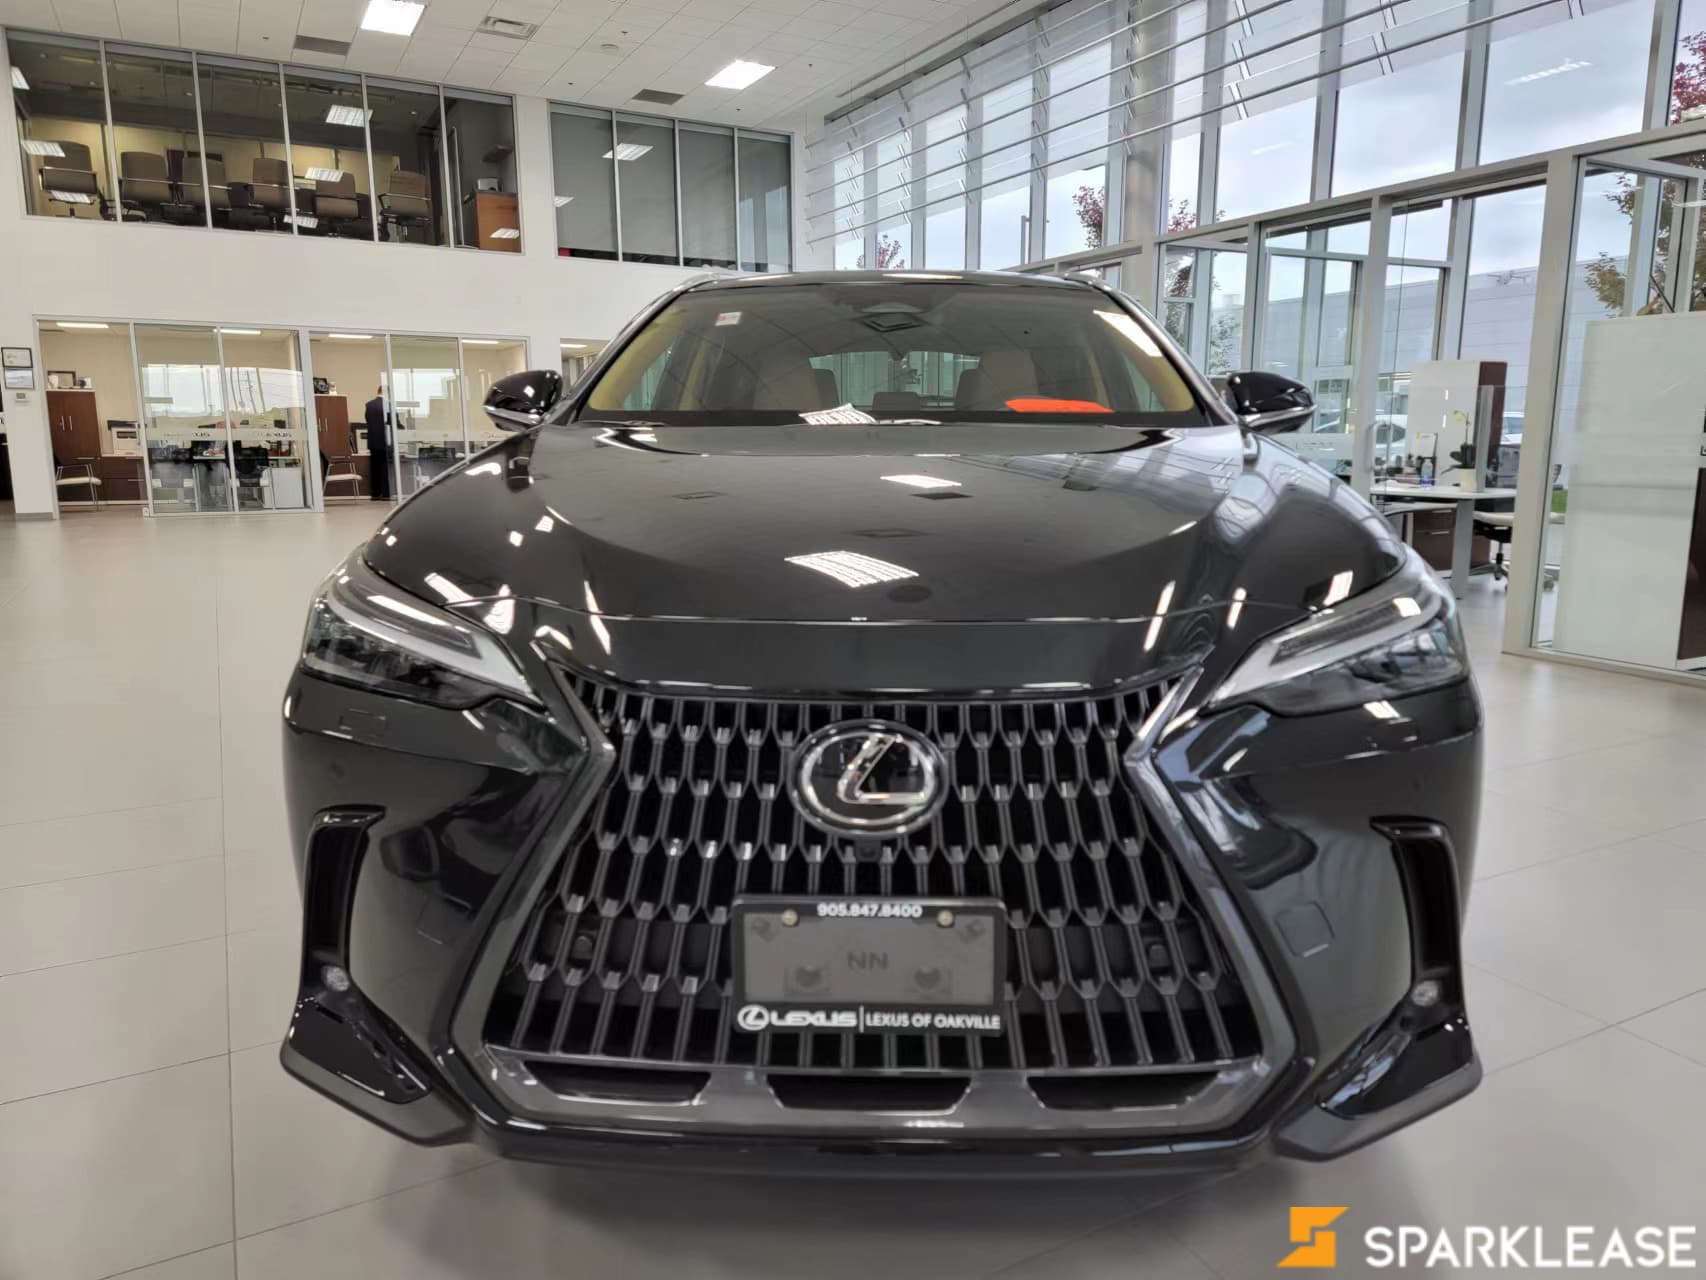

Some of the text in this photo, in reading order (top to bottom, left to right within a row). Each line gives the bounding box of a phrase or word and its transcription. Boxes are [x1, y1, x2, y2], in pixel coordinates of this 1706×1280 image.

[817, 902, 922, 918] 905.847.8400
[771, 1011, 857, 1027] LEXUS
[866, 1012, 1000, 1031] LEXUS OF OAKVILLE
